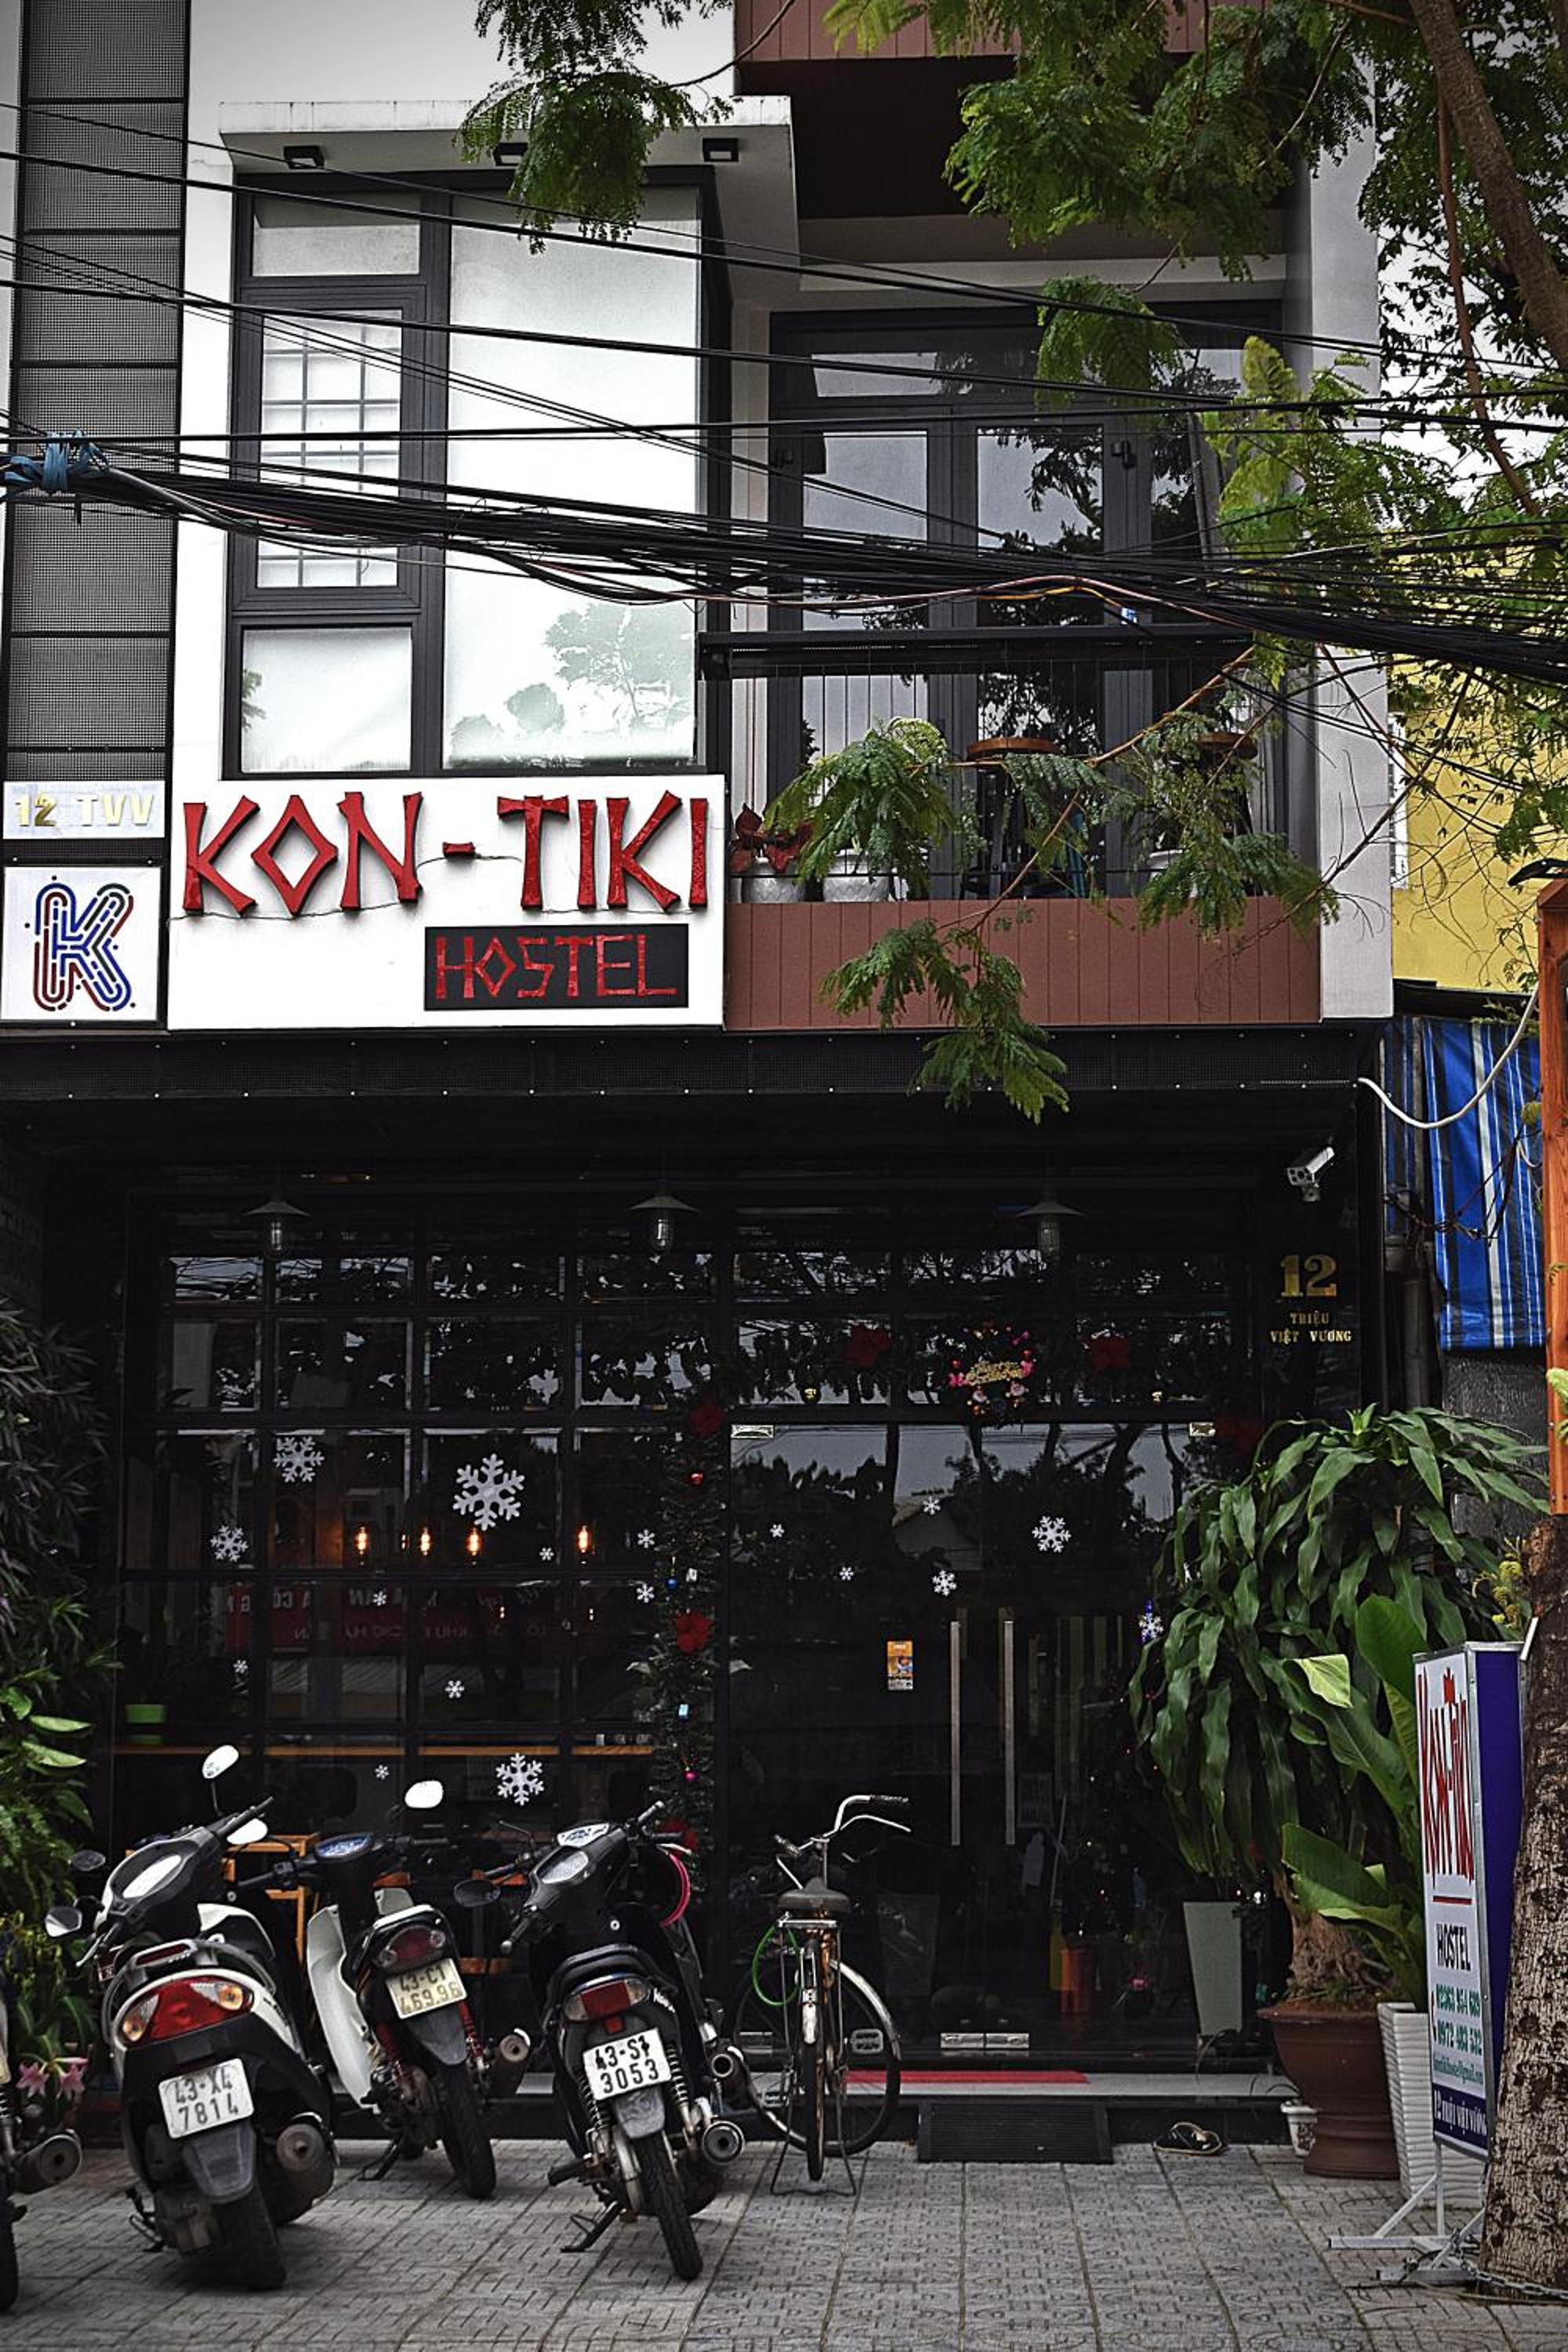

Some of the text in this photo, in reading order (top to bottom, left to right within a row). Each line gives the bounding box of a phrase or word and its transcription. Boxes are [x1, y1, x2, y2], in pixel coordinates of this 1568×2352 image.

[15, 793, 154, 827] 12 TVV
[183, 789, 710, 918] KON-TIKI
[435, 933, 680, 1001] HOSTEL
[1280, 1254, 1337, 1297] 12
[1436, 1923, 1472, 1972] HOSTEL
[399, 1965, 446, 1993] 43-C1
[594, 2034, 650, 2071] 43-S1
[600, 2058, 659, 2093] 3053
[178, 2092, 239, 2131] 7814
